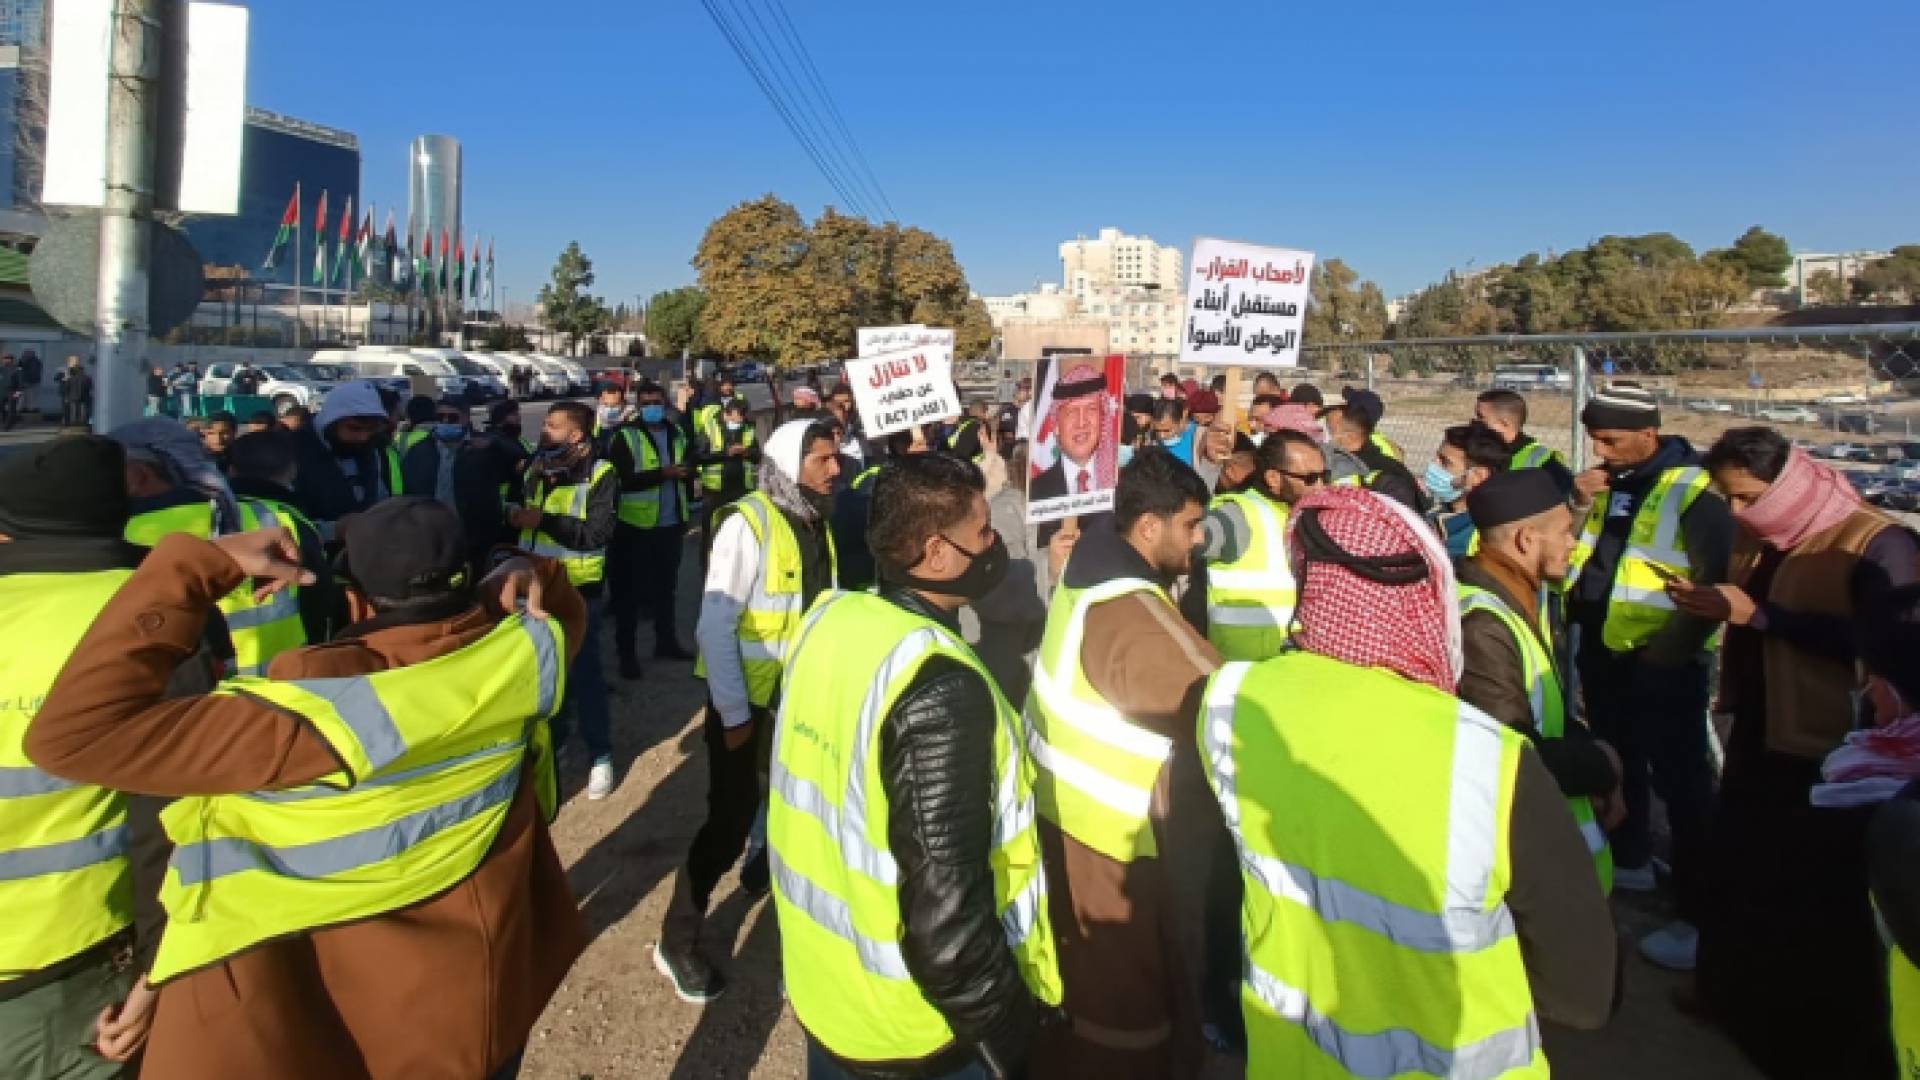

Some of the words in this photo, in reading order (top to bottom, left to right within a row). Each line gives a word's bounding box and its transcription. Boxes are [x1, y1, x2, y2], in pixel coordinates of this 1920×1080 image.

[1252, 259, 1305, 285] لأصحاب
[1193, 283, 1230, 316] أبناء
[1230, 291, 1298, 319] مستقبل
[1188, 315, 1242, 351] للأسوأ
[1244, 326, 1298, 355] الوطن
[869, 359, 911, 389] تنازل
[912, 353, 927, 374] لا
[916, 382, 935, 398] عن
